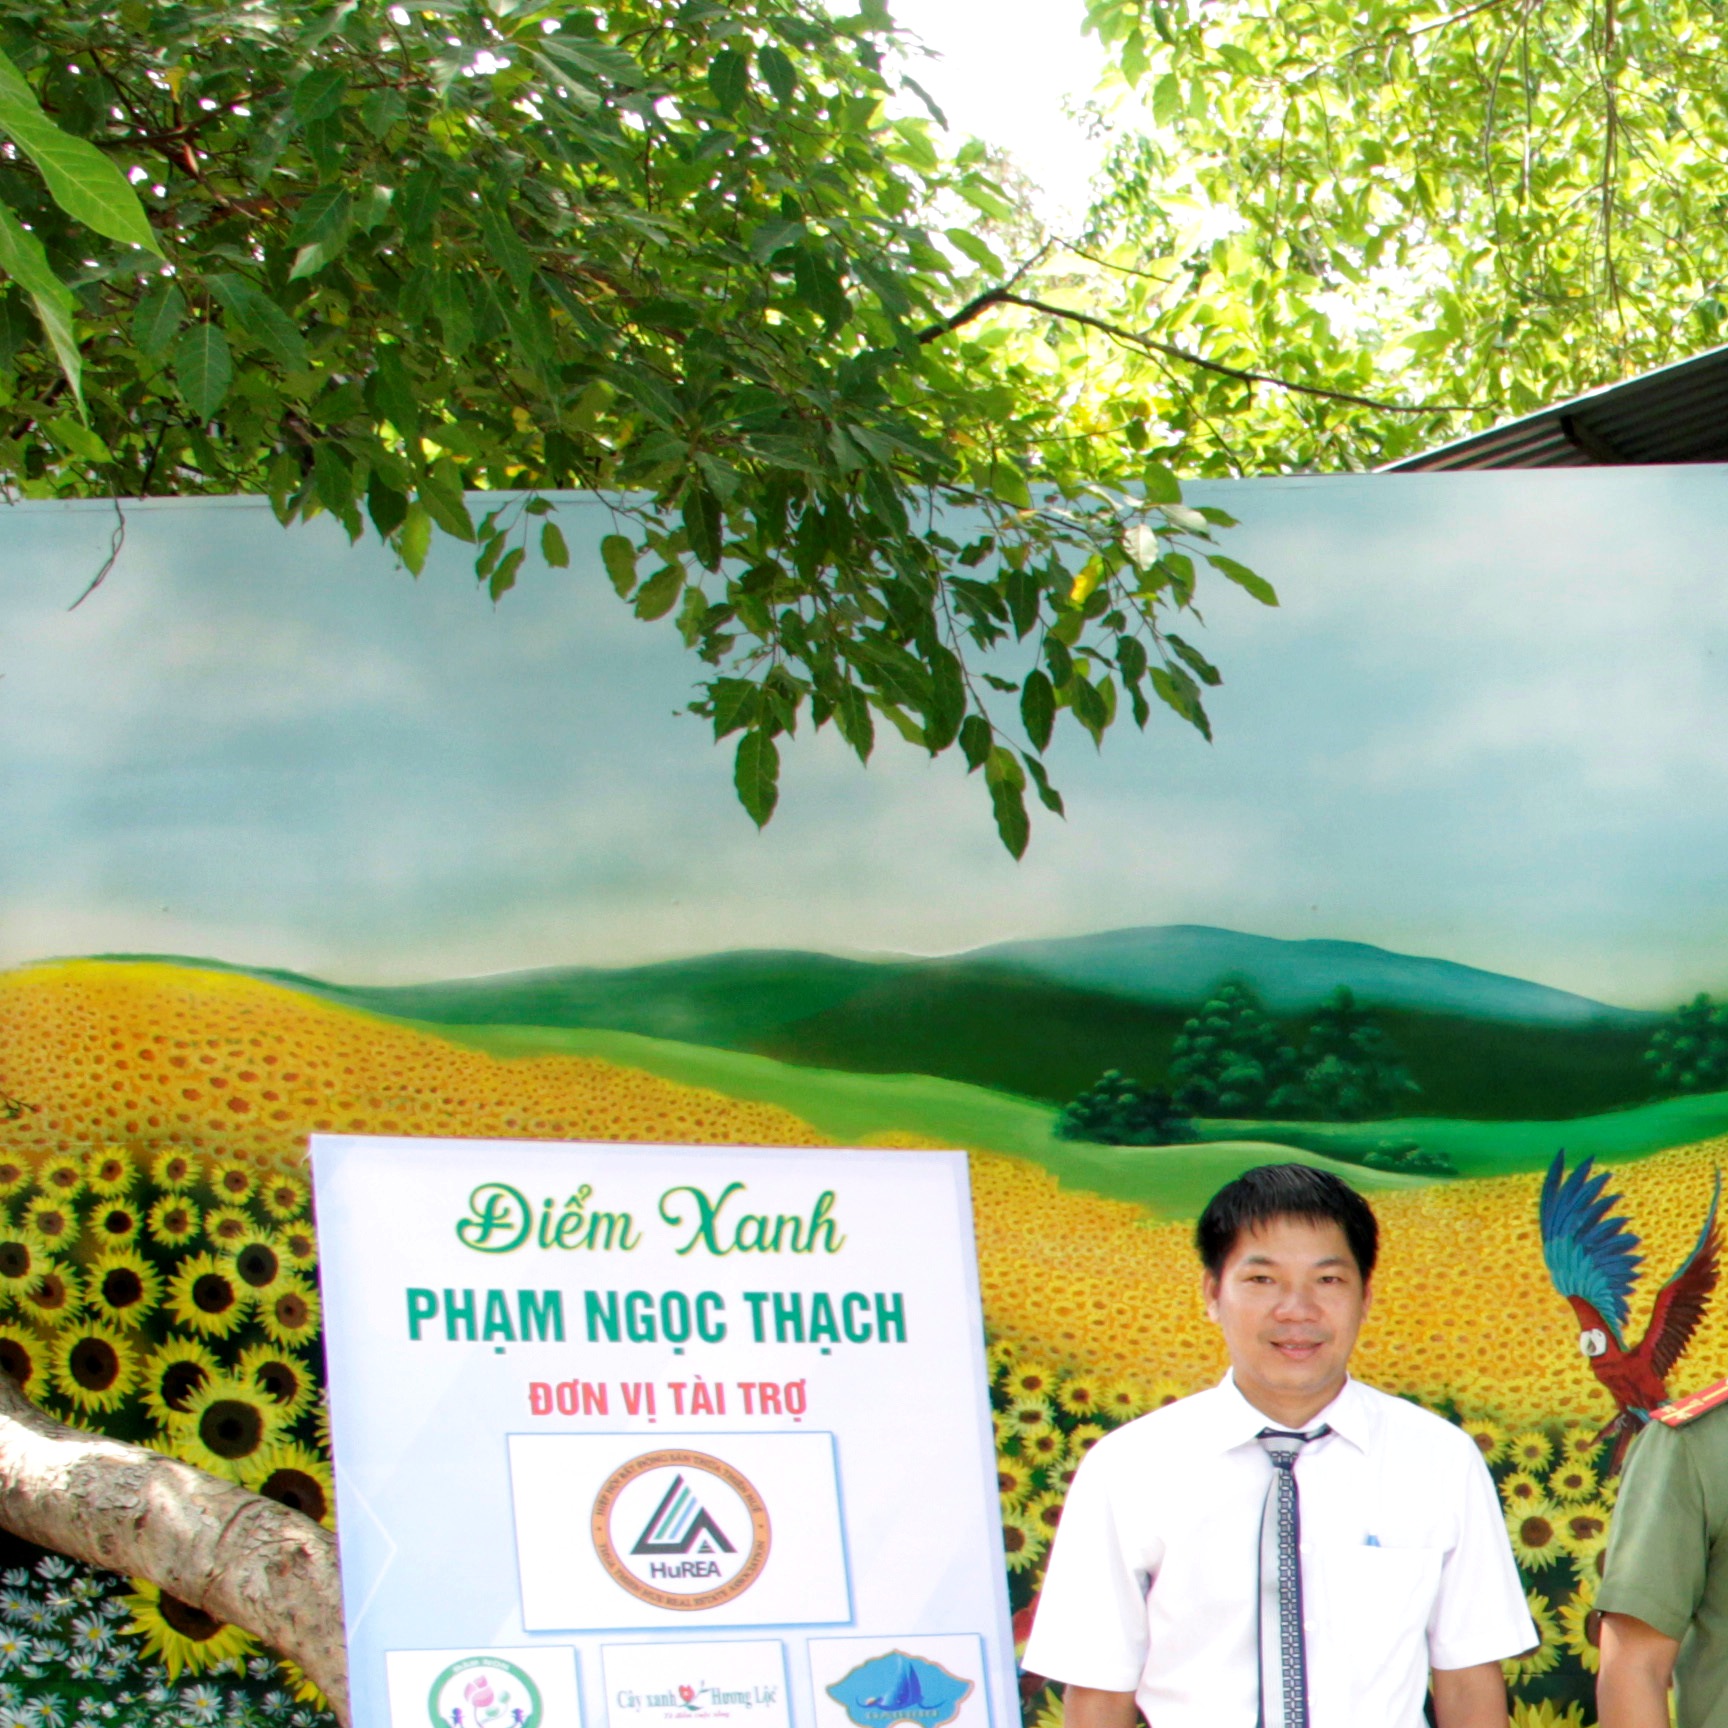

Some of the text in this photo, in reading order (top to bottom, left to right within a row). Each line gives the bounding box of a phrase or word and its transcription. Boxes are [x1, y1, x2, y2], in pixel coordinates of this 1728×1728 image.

[456, 1181, 846, 1256] Điểm Xanh
[406, 1287, 908, 1355] PHẠM NGỌC THẠCH
[529, 1375, 808, 1423] ĐƠN VỊ TÀI TRỢ
[650, 1561, 722, 1578] HuREA
